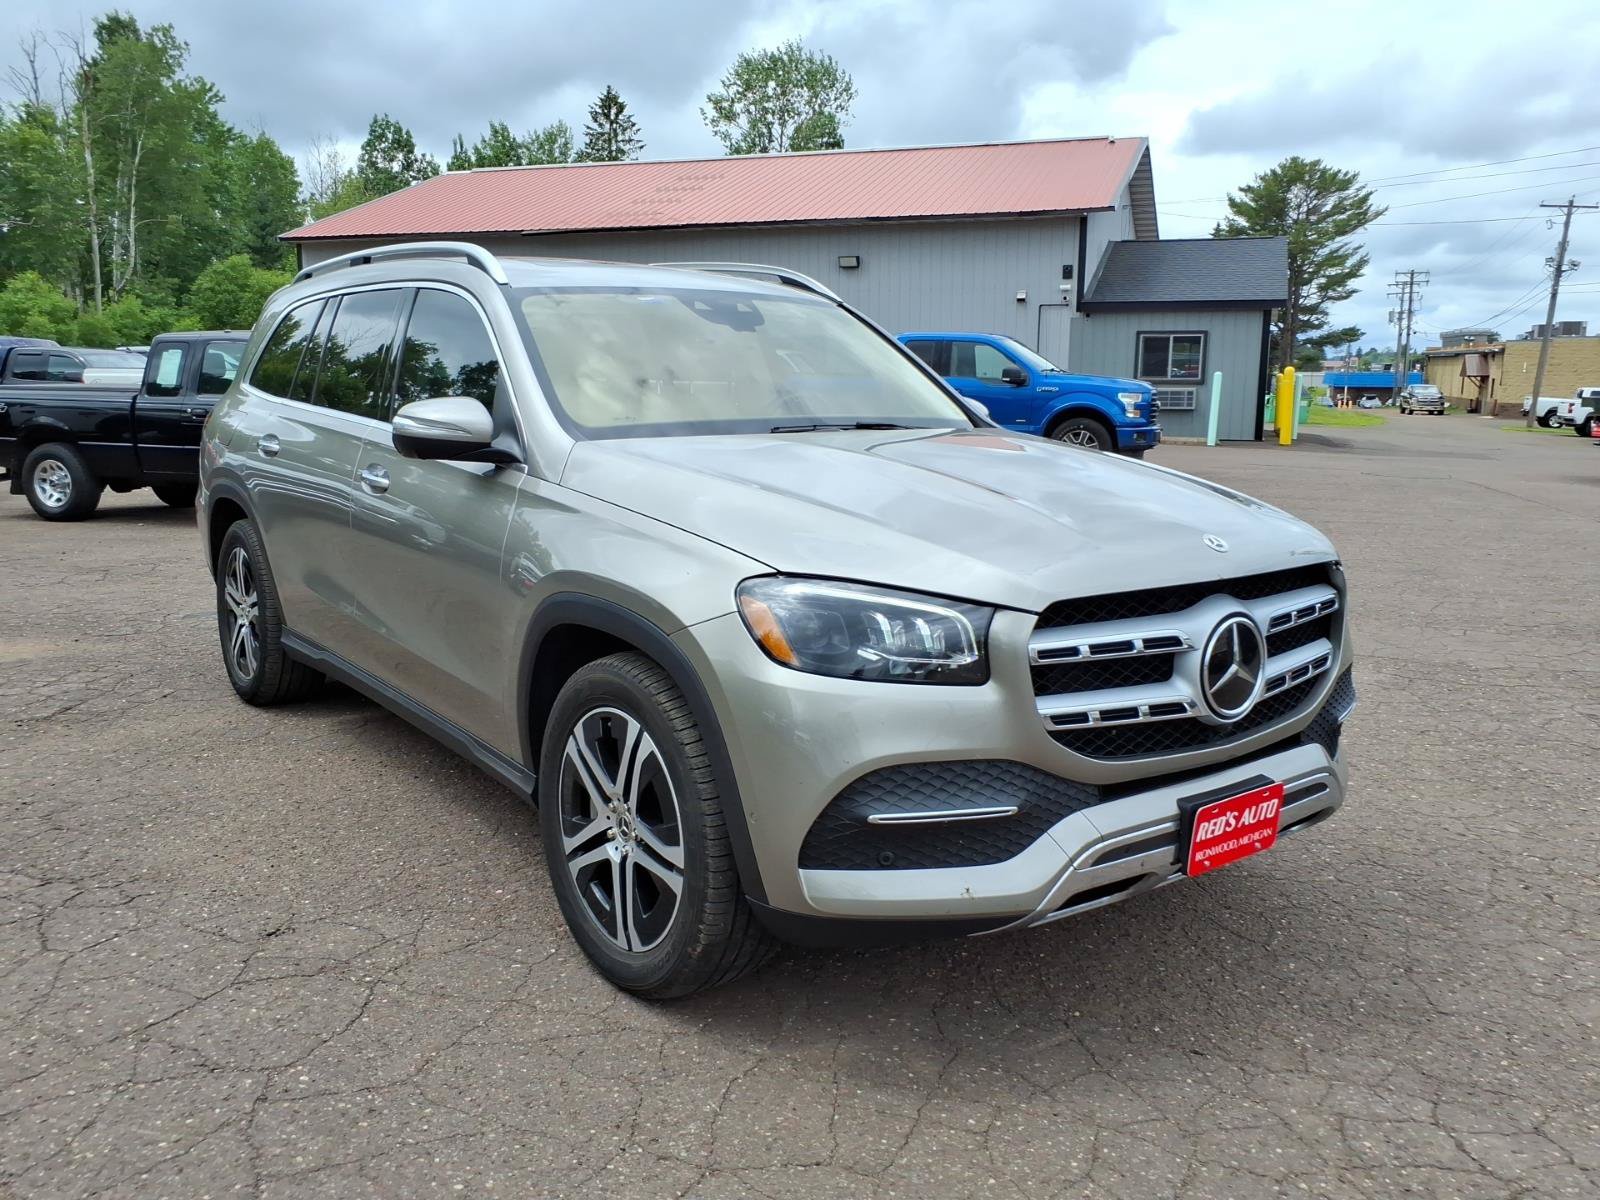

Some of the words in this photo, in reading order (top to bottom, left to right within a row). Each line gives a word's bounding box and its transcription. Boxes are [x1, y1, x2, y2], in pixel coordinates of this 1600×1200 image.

[1195, 811, 1238, 842] RED'S
[1237, 798, 1279, 828] AUTO
[1238, 827, 1273, 846] MICHIGAN
